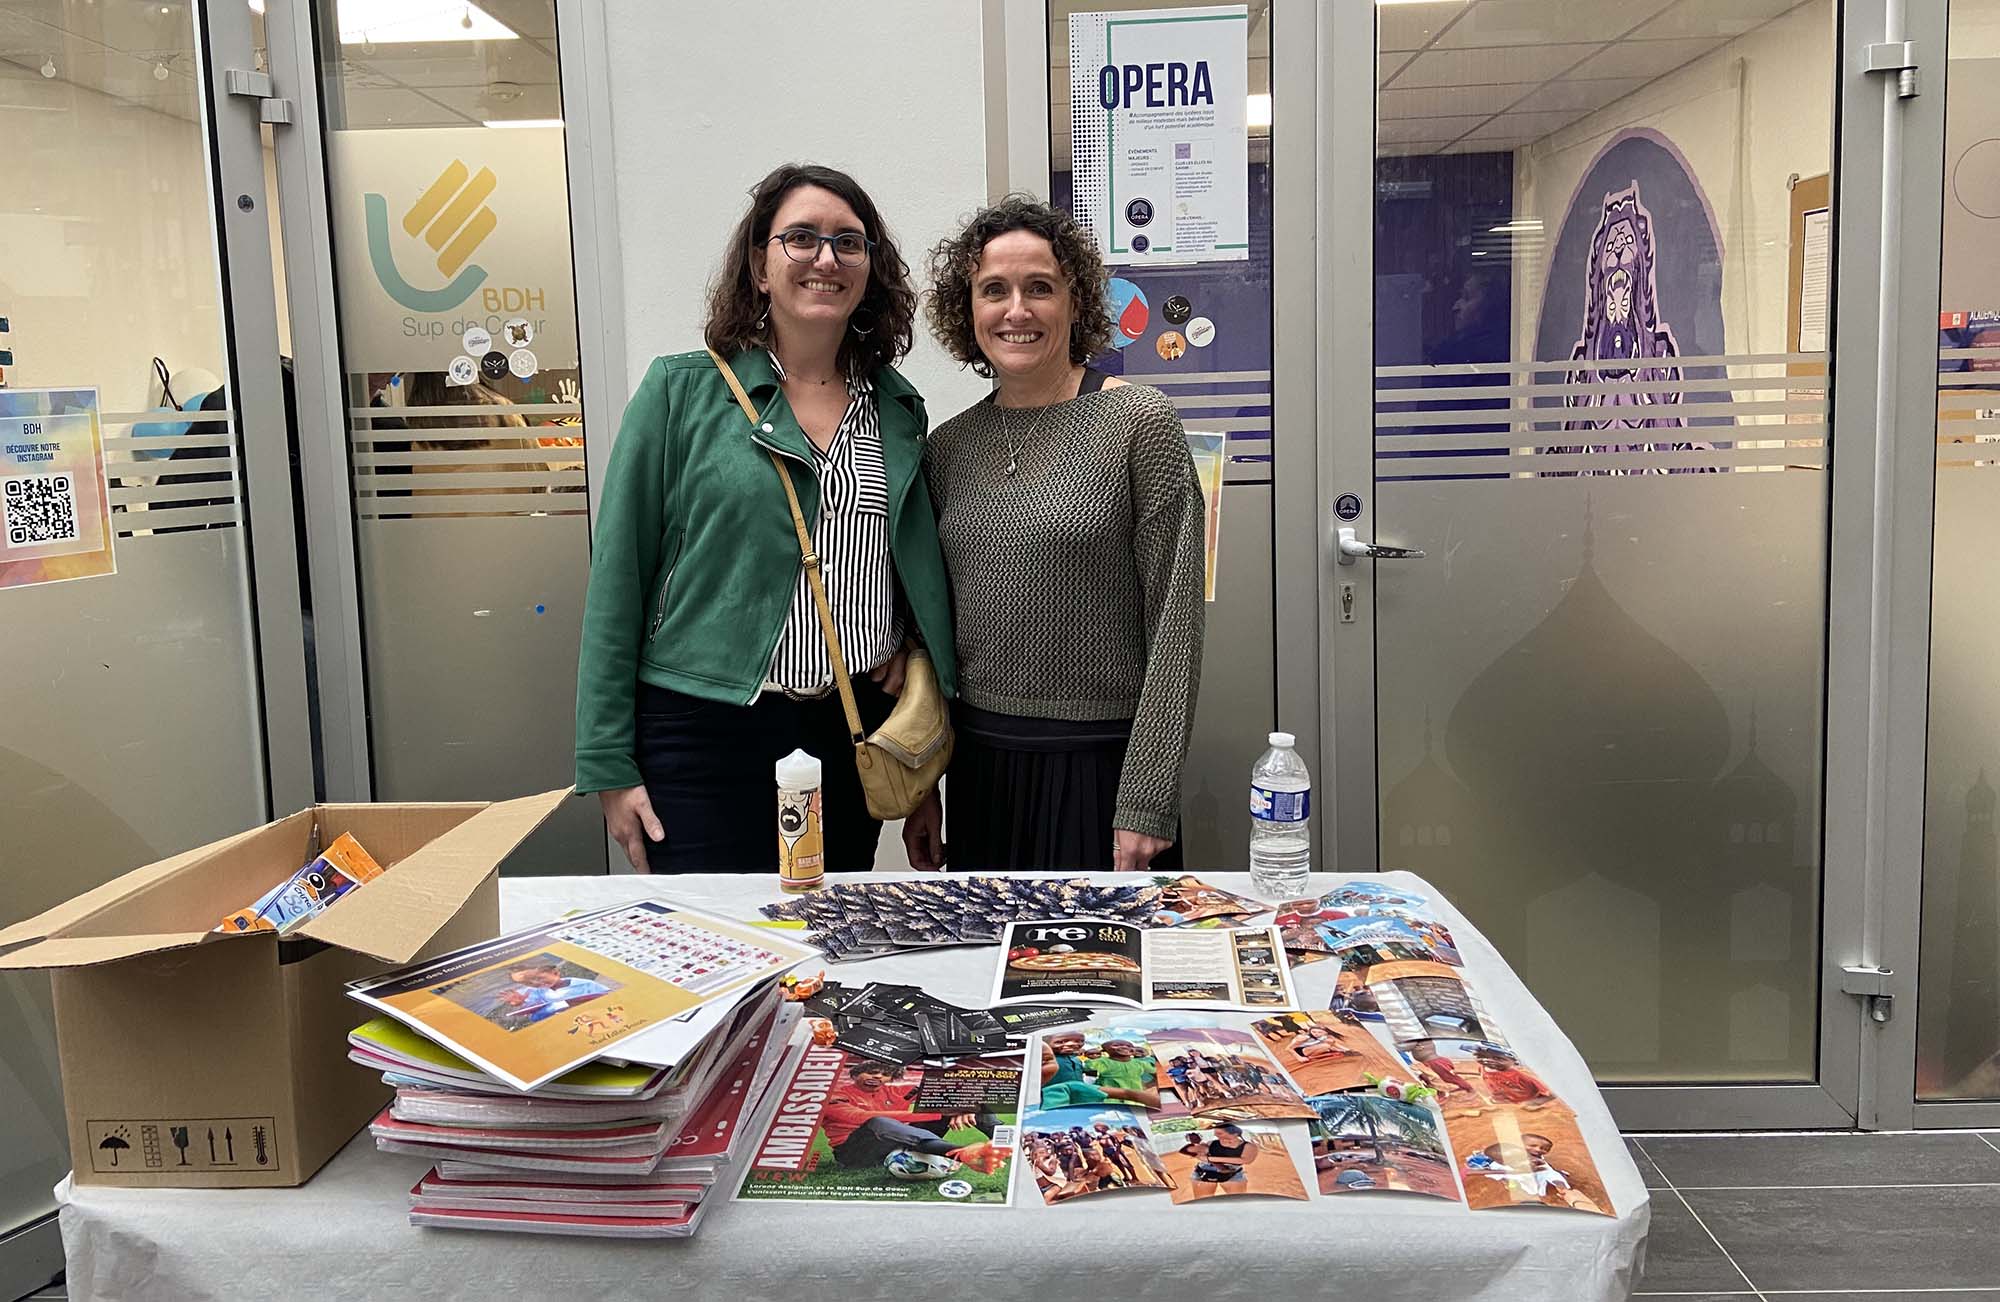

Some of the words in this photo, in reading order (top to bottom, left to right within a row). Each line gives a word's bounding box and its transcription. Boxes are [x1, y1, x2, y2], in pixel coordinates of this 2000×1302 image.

[1099, 61, 1214, 110] OPERA
[483, 287, 545, 313] BDH
[403, 316, 444, 339] Sup
[452, 315, 478, 336] de
[23, 423, 42, 435] BDH
[6, 443, 39, 454] DÉCOUVRE
[40, 442, 61, 452] NOTRE
[17, 452, 54, 463] INSTAGRAM
[426, 972, 443, 981] des
[443, 955, 493, 975] fournitures
[755, 1172, 808, 1182] NEW
